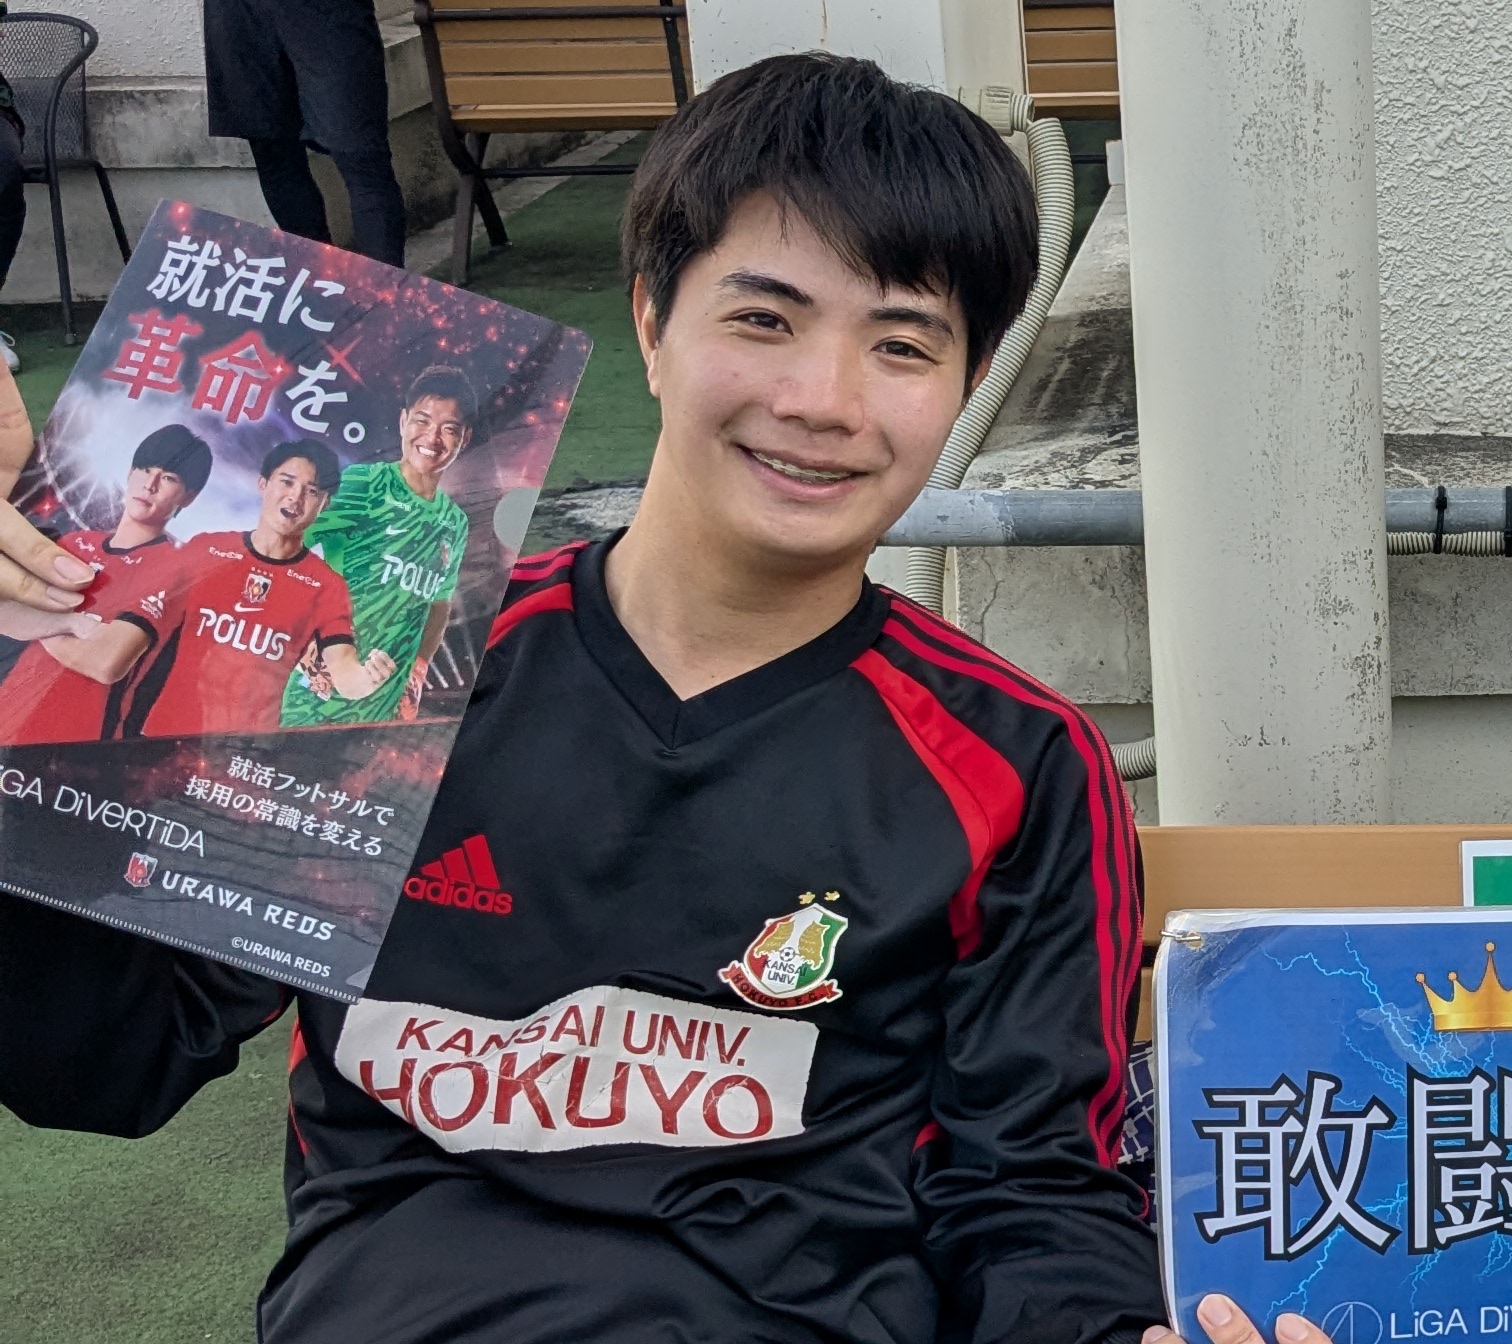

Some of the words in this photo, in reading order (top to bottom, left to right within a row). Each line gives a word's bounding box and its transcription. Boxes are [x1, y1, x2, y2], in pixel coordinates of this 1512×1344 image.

[146, 235, 346, 332] 就活に
[101, 307, 366, 444] 革命を。
[196, 607, 292, 661] POLUS
[184, 775, 383, 857] 採用の常識を変える
[225, 755, 395, 827] 就活フットサルで
[162, 869, 254, 917] URAWA
[263, 903, 338, 942] REDS
[404, 876, 513, 916] adidas
[293, 956, 332, 978] REDS
[763, 959, 807, 977] KANSAI
[396, 1004, 606, 1057] KANSAI
[622, 1010, 752, 1067] UNIV.
[359, 1050, 774, 1140] HOKUYO
